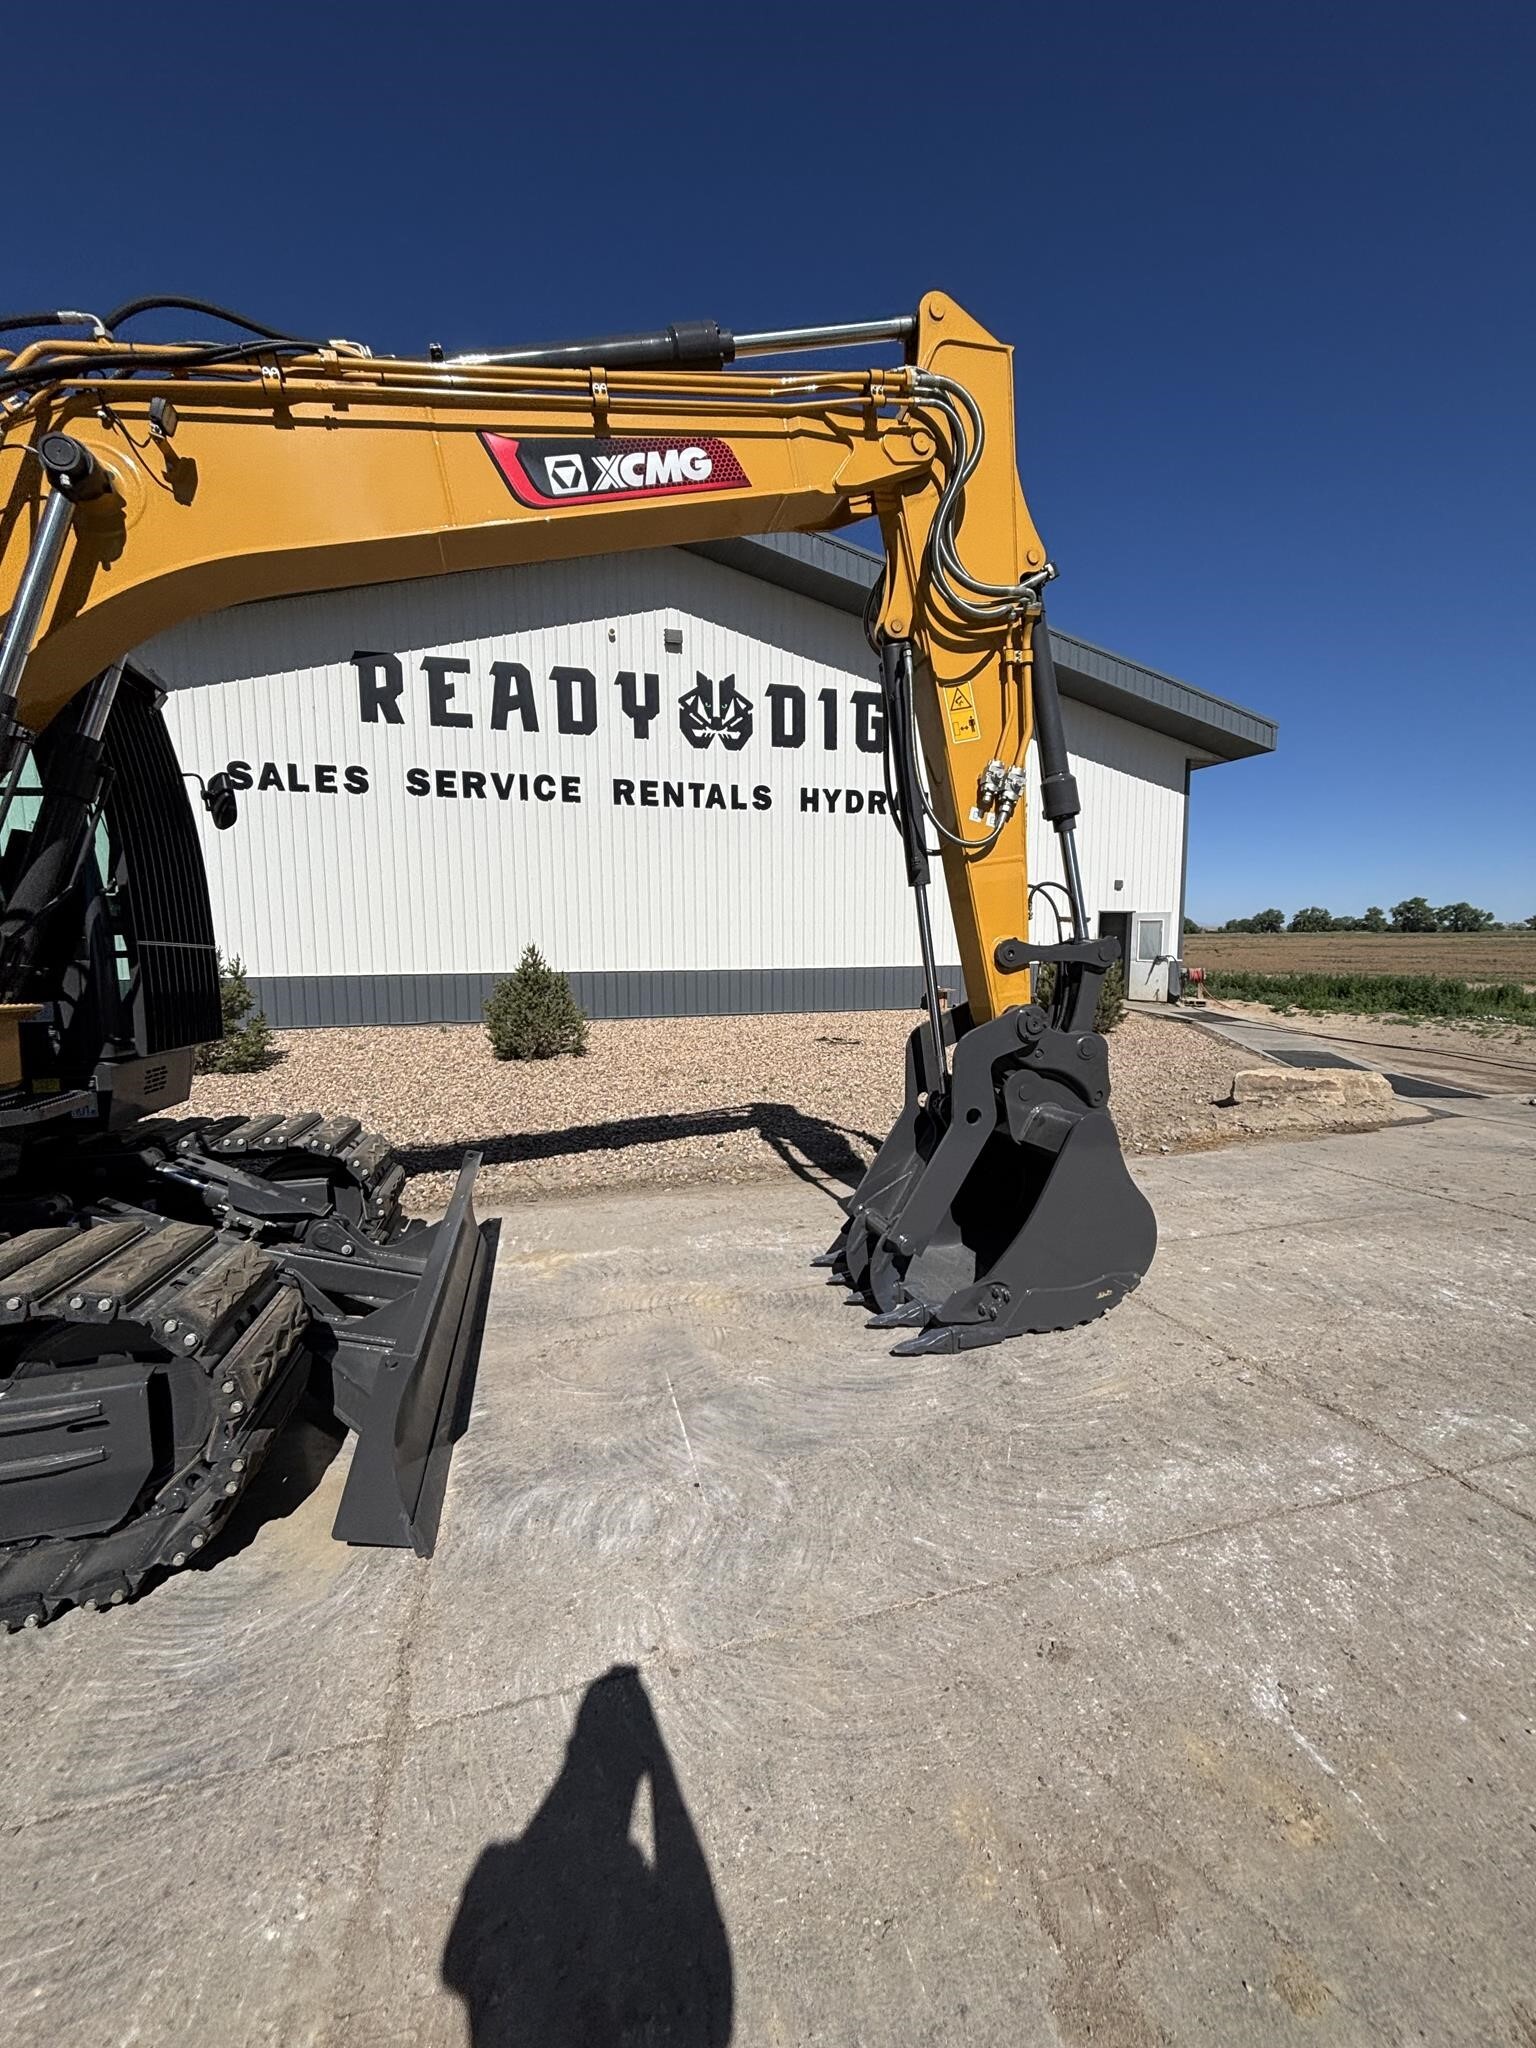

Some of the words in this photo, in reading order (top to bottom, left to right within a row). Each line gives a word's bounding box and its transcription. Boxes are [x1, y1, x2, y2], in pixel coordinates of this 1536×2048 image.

[591, 446, 713, 491] XCMG
[350, 650, 661, 740] READY
[764, 683, 884, 754] DIG
[226, 760, 370, 795] SALES
[405, 767, 582, 803] SERVICE
[612, 778, 773, 812] RENTALS
